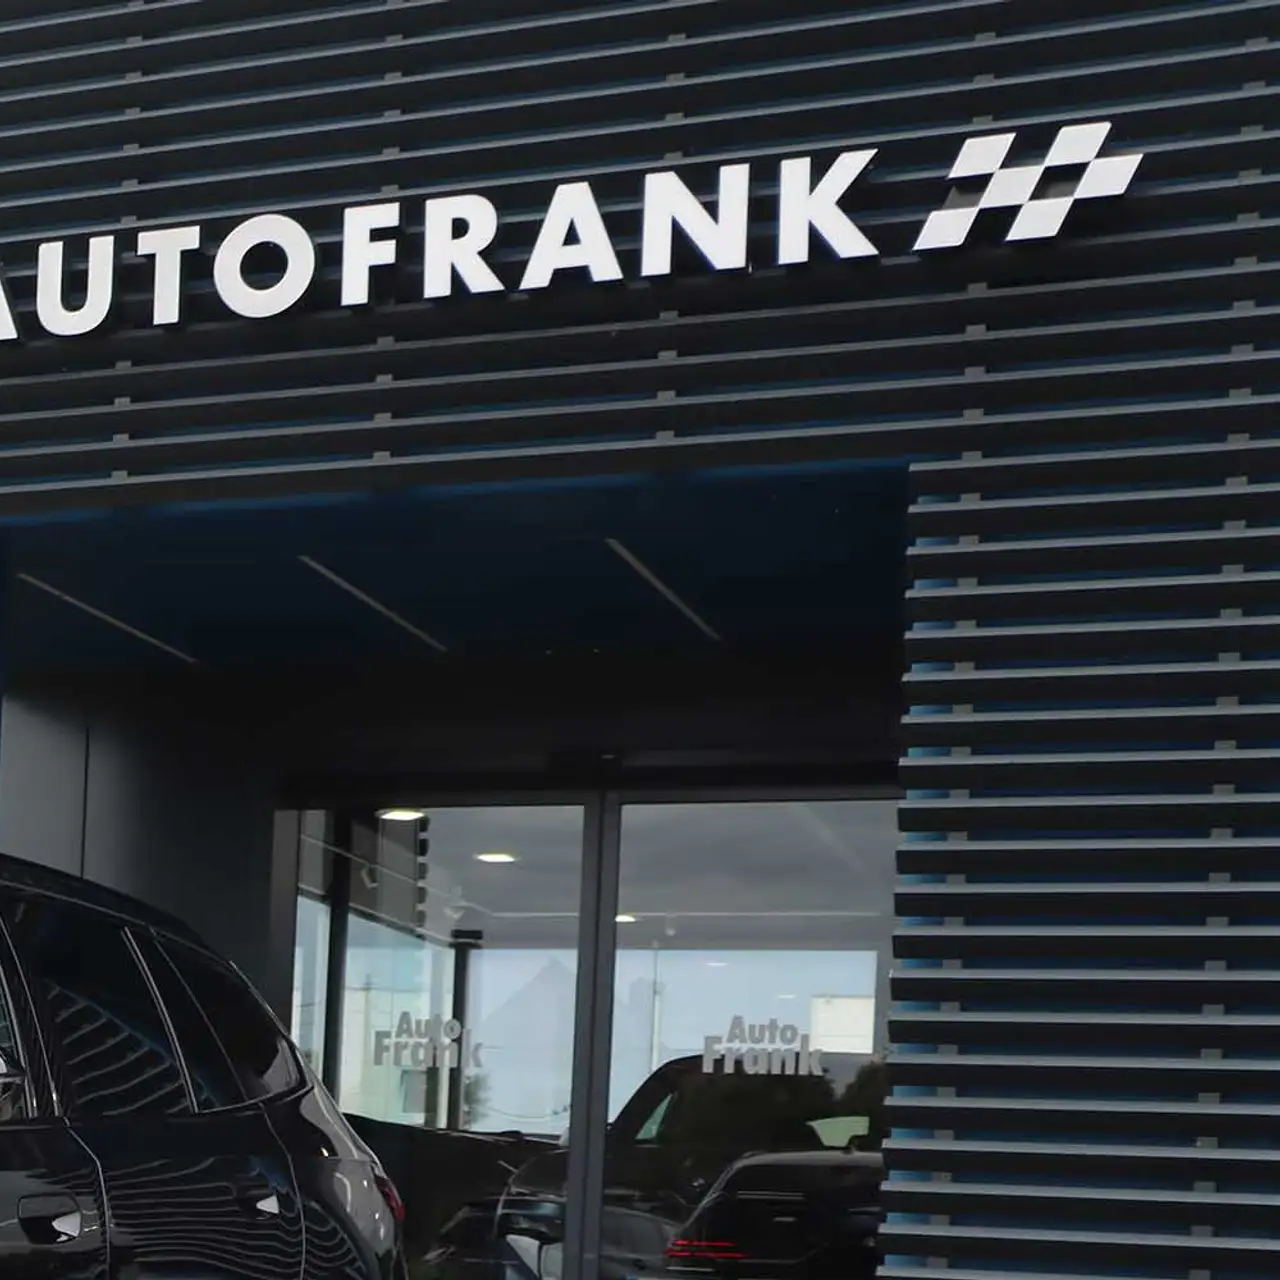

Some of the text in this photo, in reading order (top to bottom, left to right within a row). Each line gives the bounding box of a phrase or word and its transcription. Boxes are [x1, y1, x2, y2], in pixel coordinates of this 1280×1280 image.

[395, 1010, 462, 1040] Auto
[725, 1013, 798, 1044] Auto
[373, 1028, 484, 1068] Frank
[702, 1034, 824, 1076] Frank
